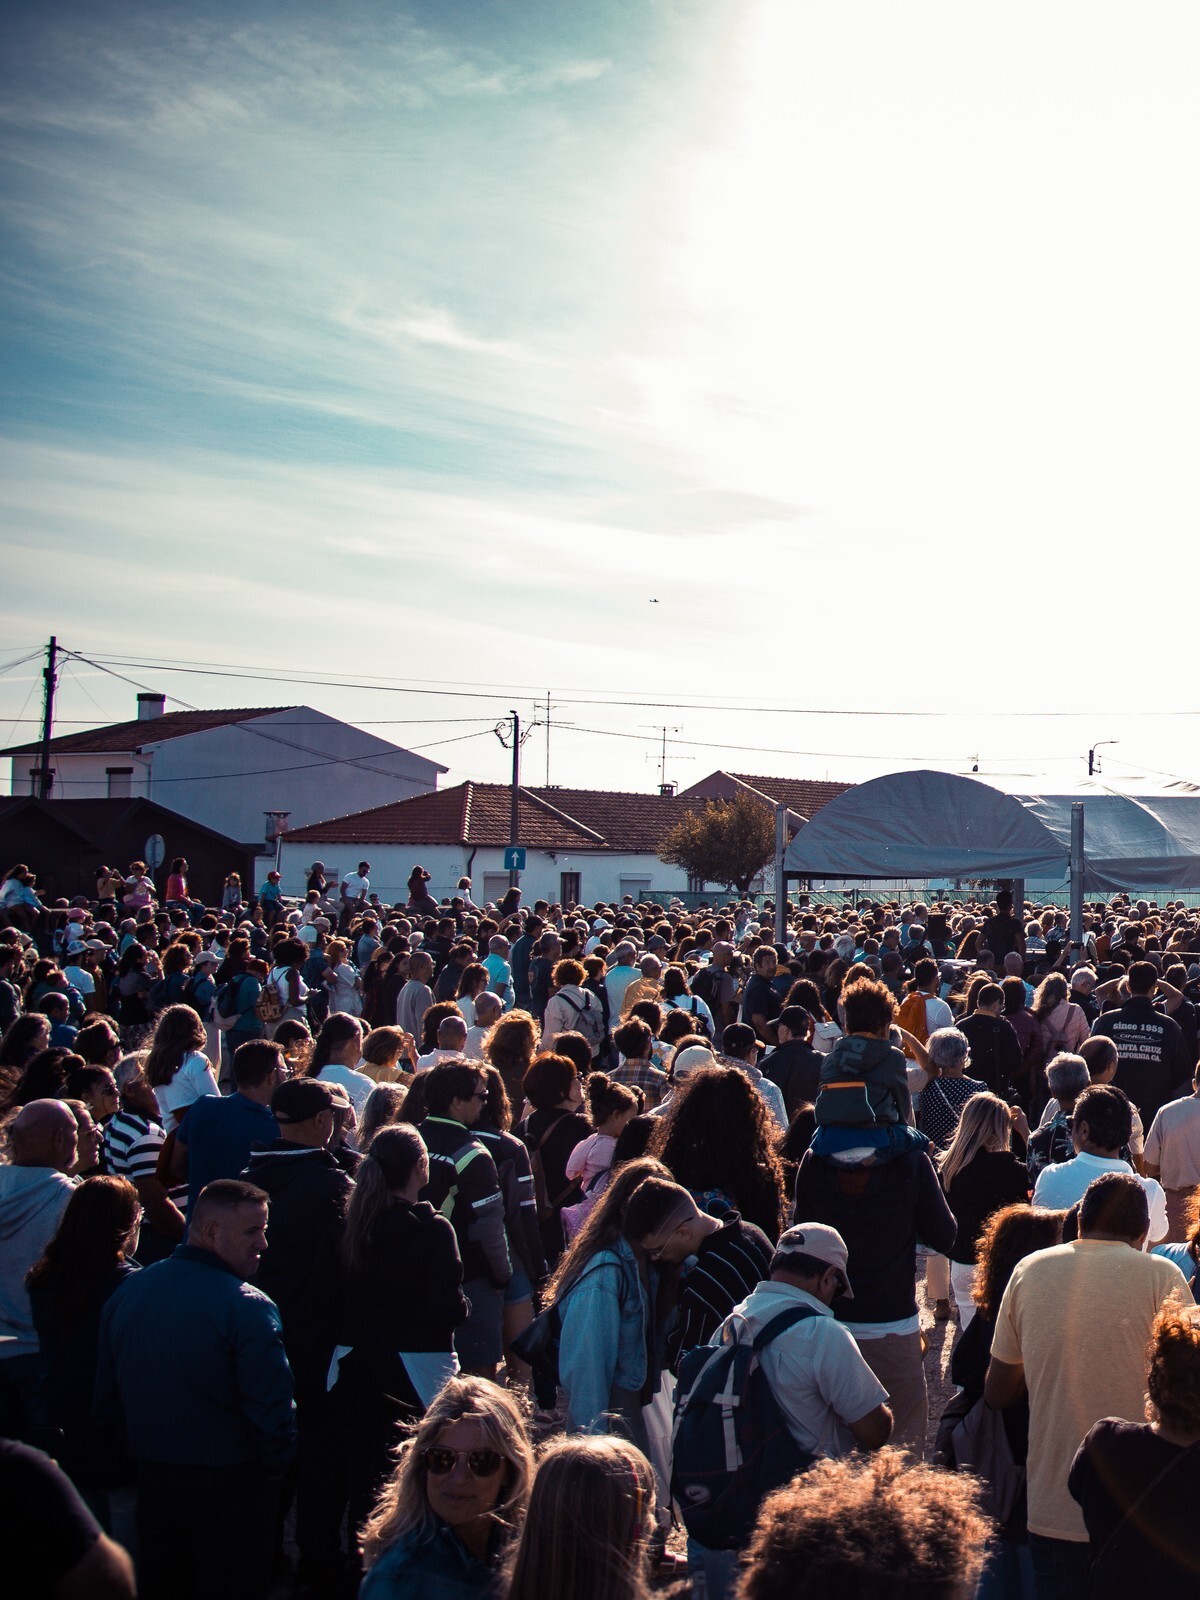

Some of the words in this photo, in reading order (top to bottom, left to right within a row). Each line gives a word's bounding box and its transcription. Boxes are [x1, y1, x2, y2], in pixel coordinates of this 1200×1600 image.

[1113, 1021, 1137, 1030] since
[1140, 1023, 1164, 1034] 1952
[1140, 1044, 1162, 1054] CRUZ
[1117, 1051, 1150, 1060] ALIFORNIA
